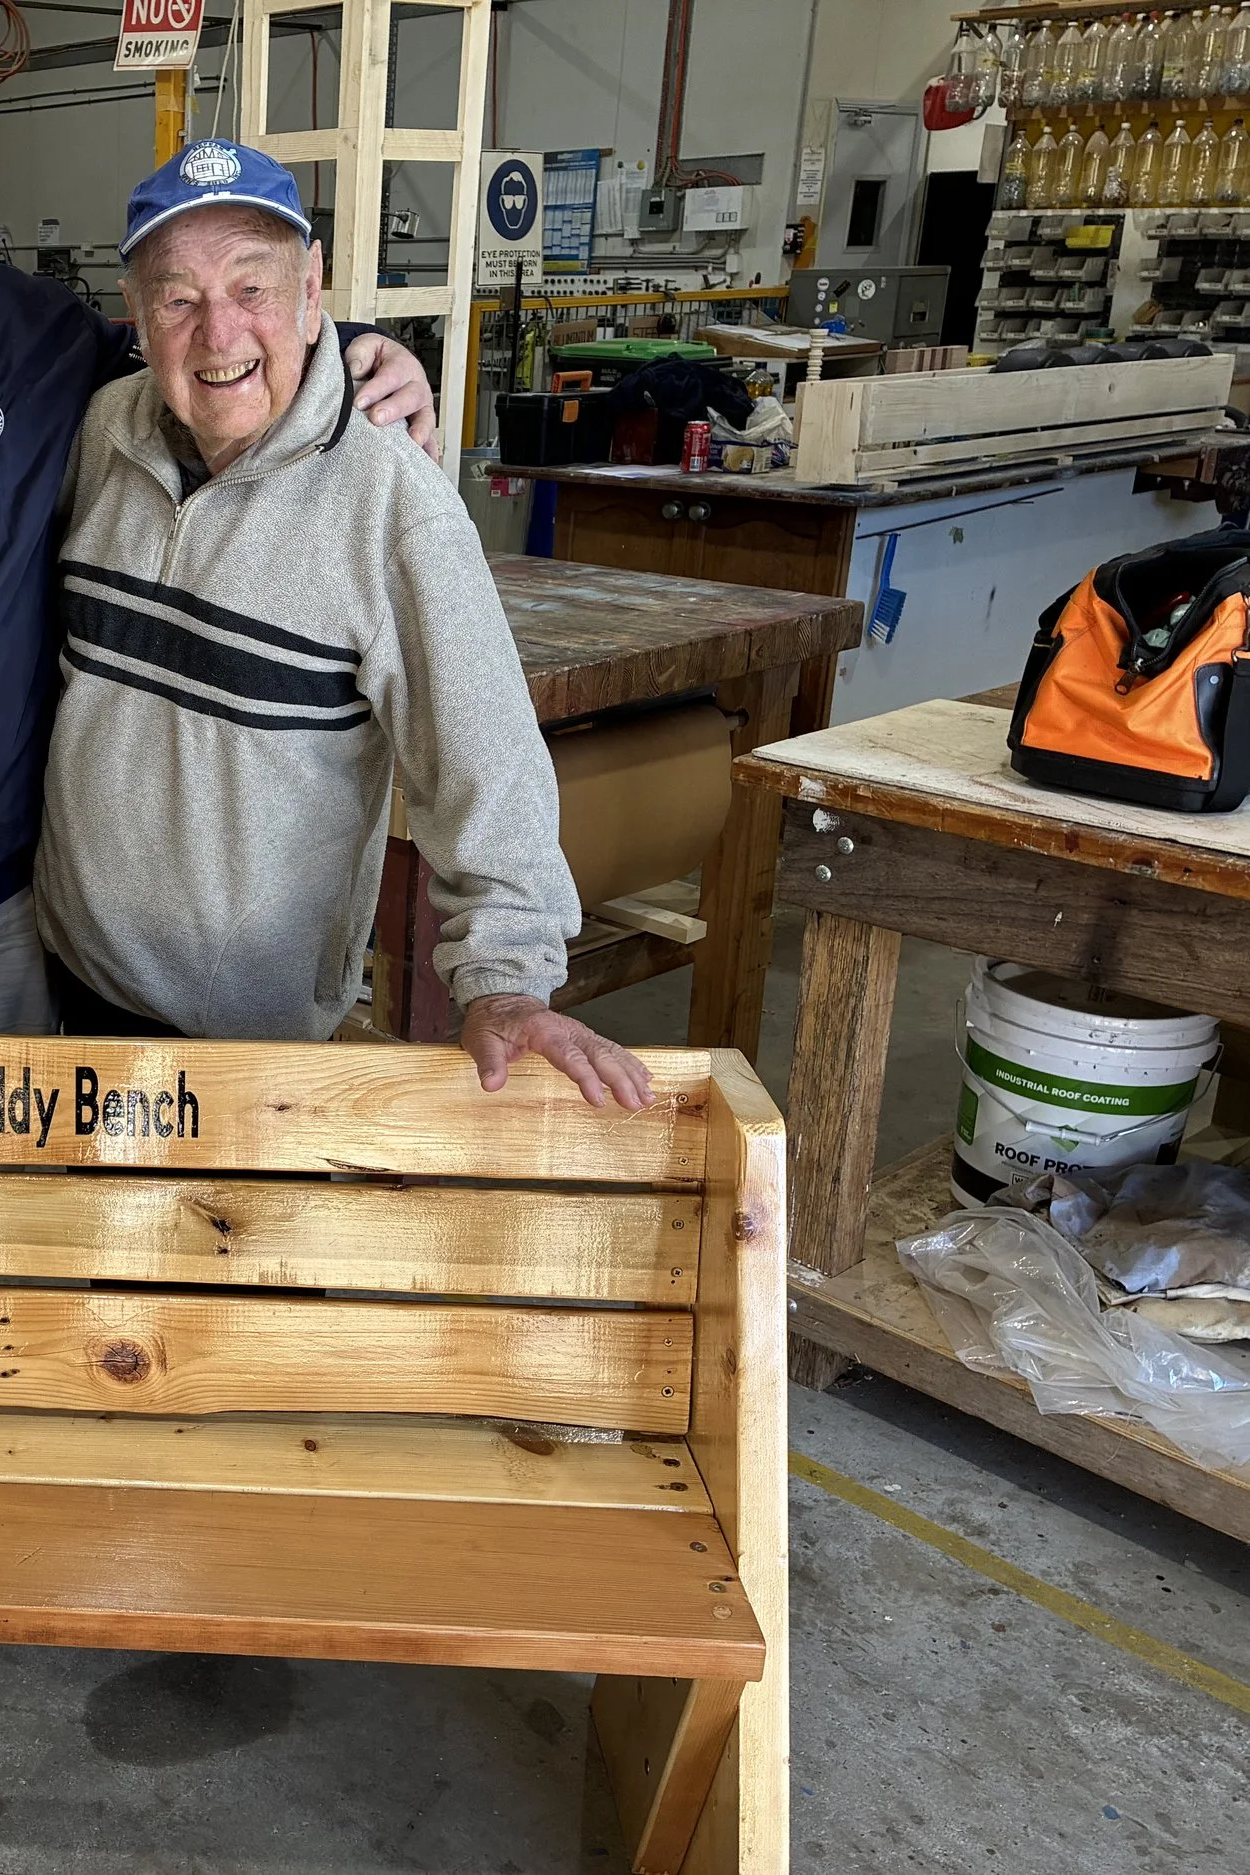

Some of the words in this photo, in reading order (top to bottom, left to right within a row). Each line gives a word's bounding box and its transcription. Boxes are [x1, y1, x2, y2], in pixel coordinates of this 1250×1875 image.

[131, 0, 165, 24] NO
[123, 39, 189, 58] SMOKING
[481, 250, 498, 259] EYE
[499, 249, 540, 258] PROTECTION
[485, 260, 507, 268] MUST
[521, 259, 537, 268] ORN
[499, 269, 515, 277] THIS
[521, 269, 535, 277] REA
[995, 1068, 1050, 1095] INDUSTRIAL
[1051, 1087, 1082, 1101] ROOF
[1082, 1093, 1130, 1107] COATING
[75, 1066, 199, 1139] Bench
[994, 1142, 1041, 1167] ROOF
